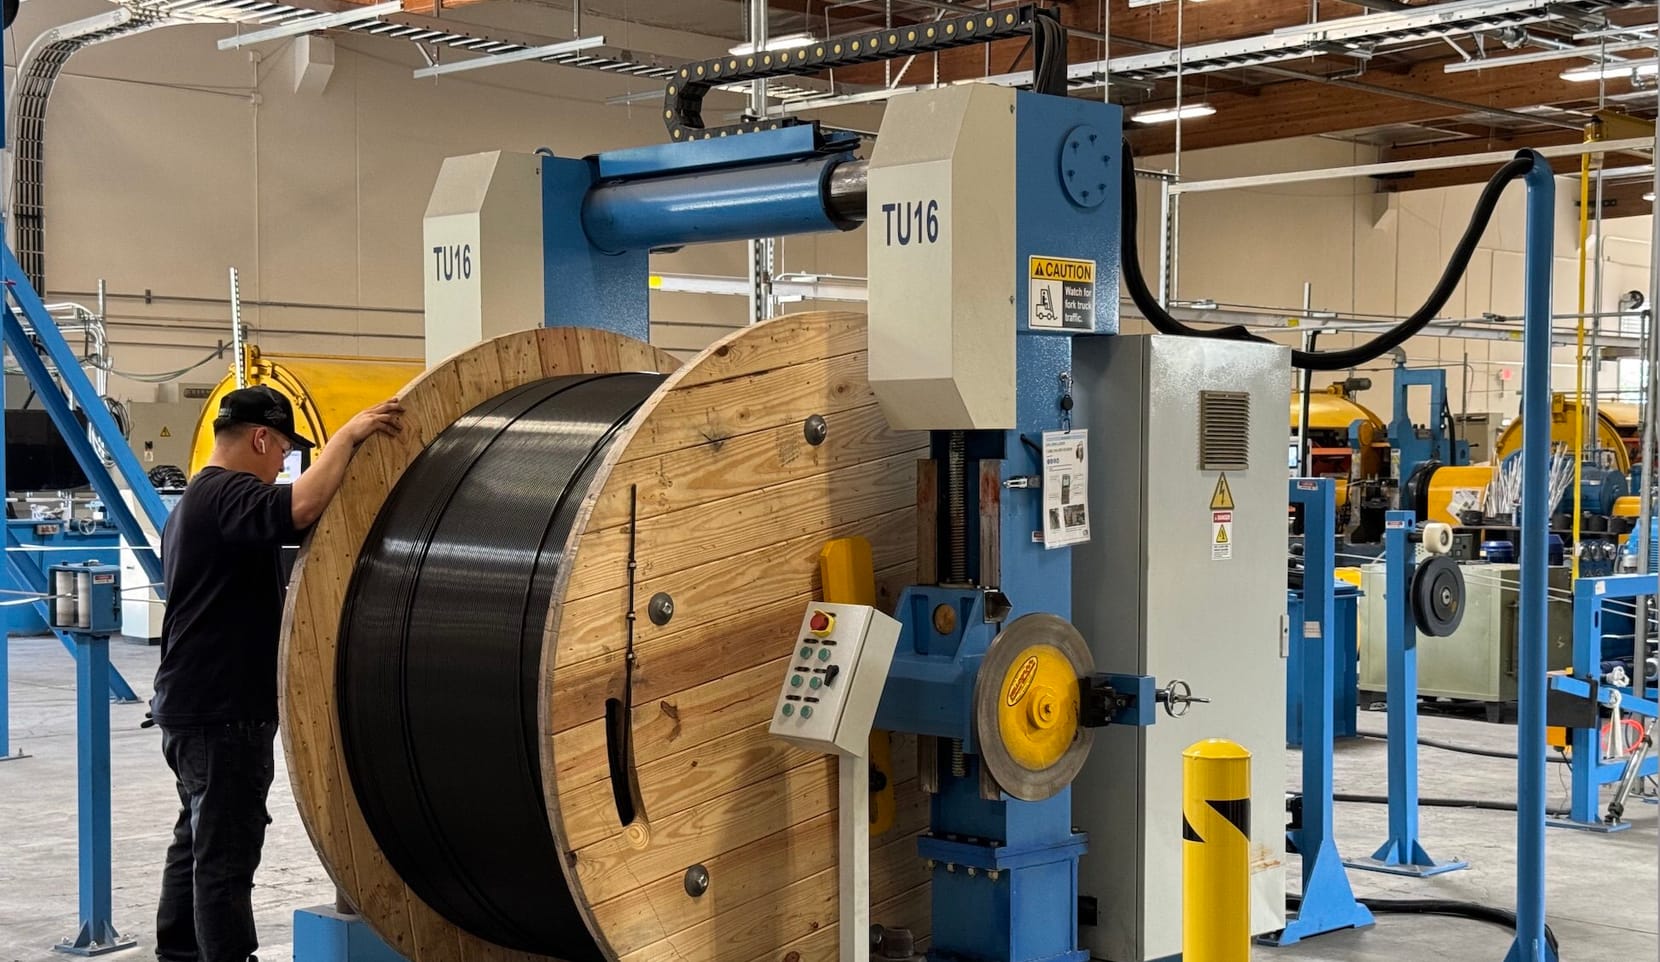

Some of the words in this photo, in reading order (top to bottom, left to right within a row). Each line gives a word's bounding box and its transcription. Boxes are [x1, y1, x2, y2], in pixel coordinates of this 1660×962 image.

[881, 199, 939, 246] TU16
[433, 244, 471, 281] TU16
[1046, 262, 1091, 280] CAUTION
[1065, 286, 1082, 297] Watch
[1083, 287, 1092, 297] for
[1065, 299, 1077, 308] fork
[1077, 300, 1092, 310] truck
[1065, 313, 1082, 323] traffic.
